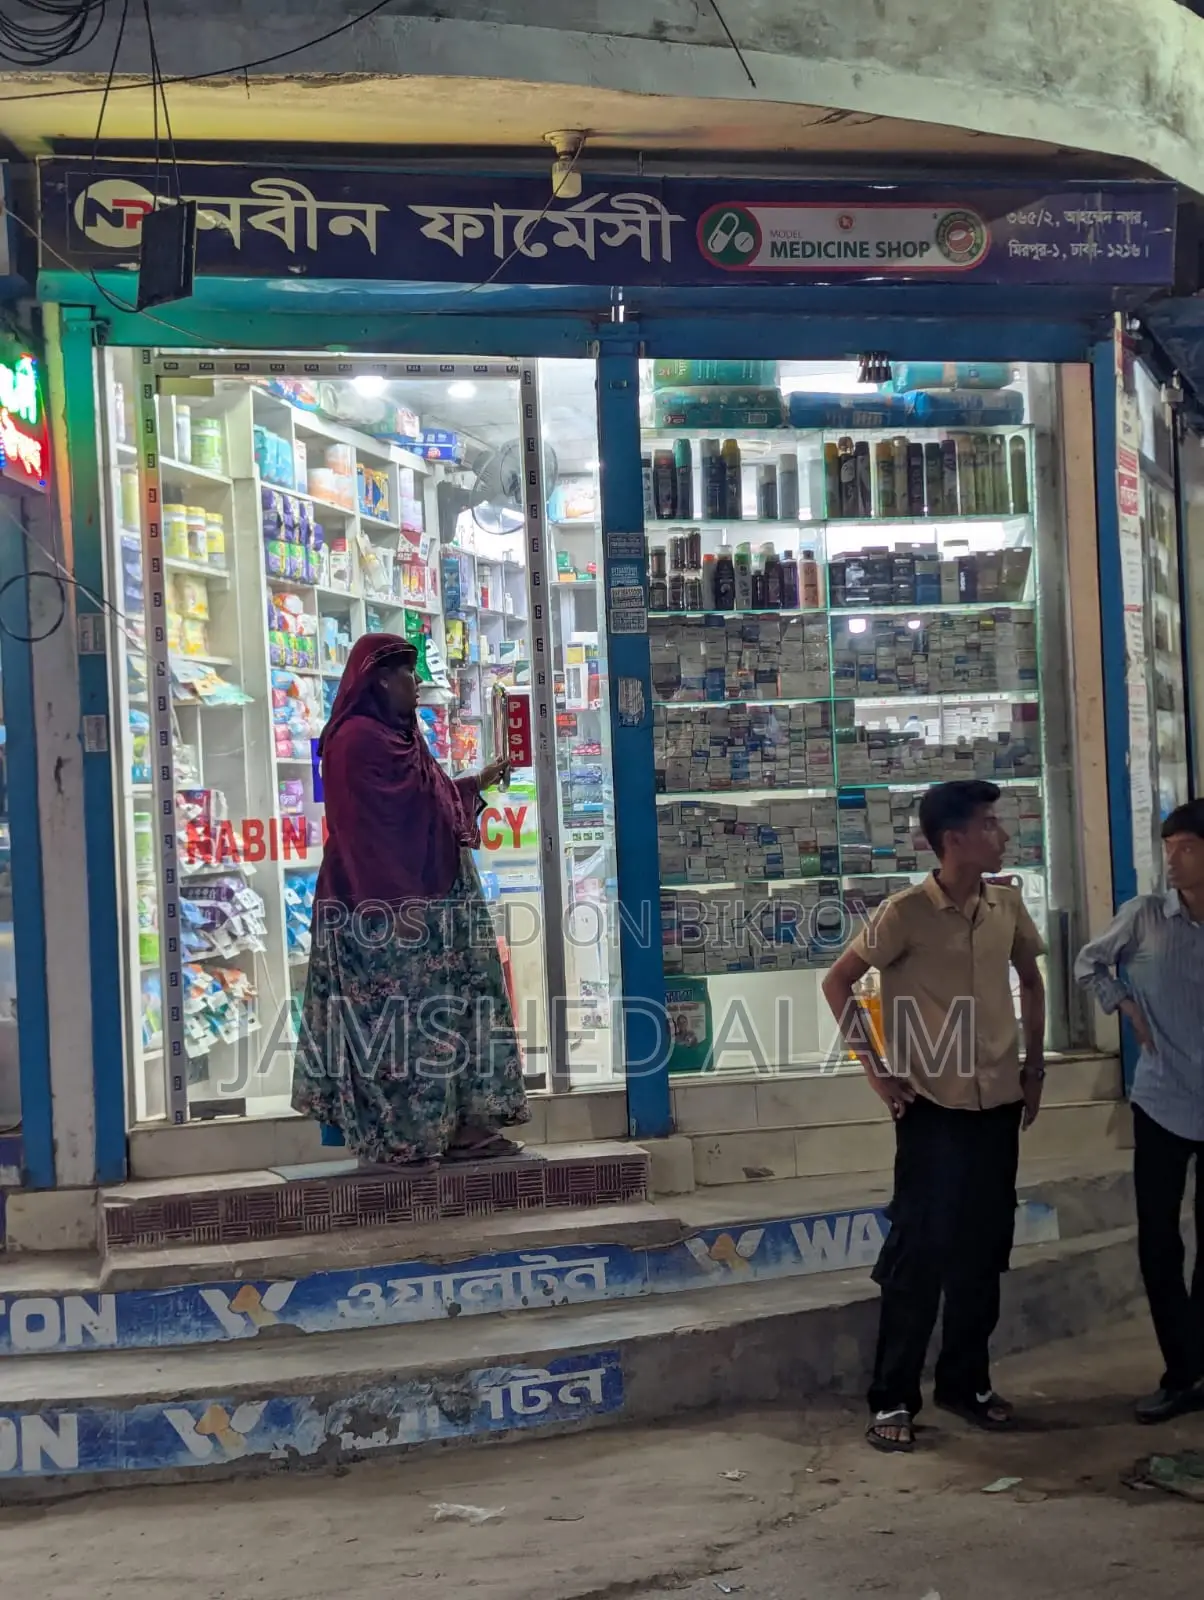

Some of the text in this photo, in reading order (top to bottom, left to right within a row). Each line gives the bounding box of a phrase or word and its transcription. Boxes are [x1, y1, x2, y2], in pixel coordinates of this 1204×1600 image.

[407, 192, 687, 263] ফার্মেসী
[769, 229, 803, 239] MODEL
[769, 240, 931, 259] MEDICINE SHOP
[509, 701, 525, 761] PUSH
[186, 816, 308, 864] NABIN
[789, 1212, 885, 1268] WA
[0, 1293, 118, 1348] ON
